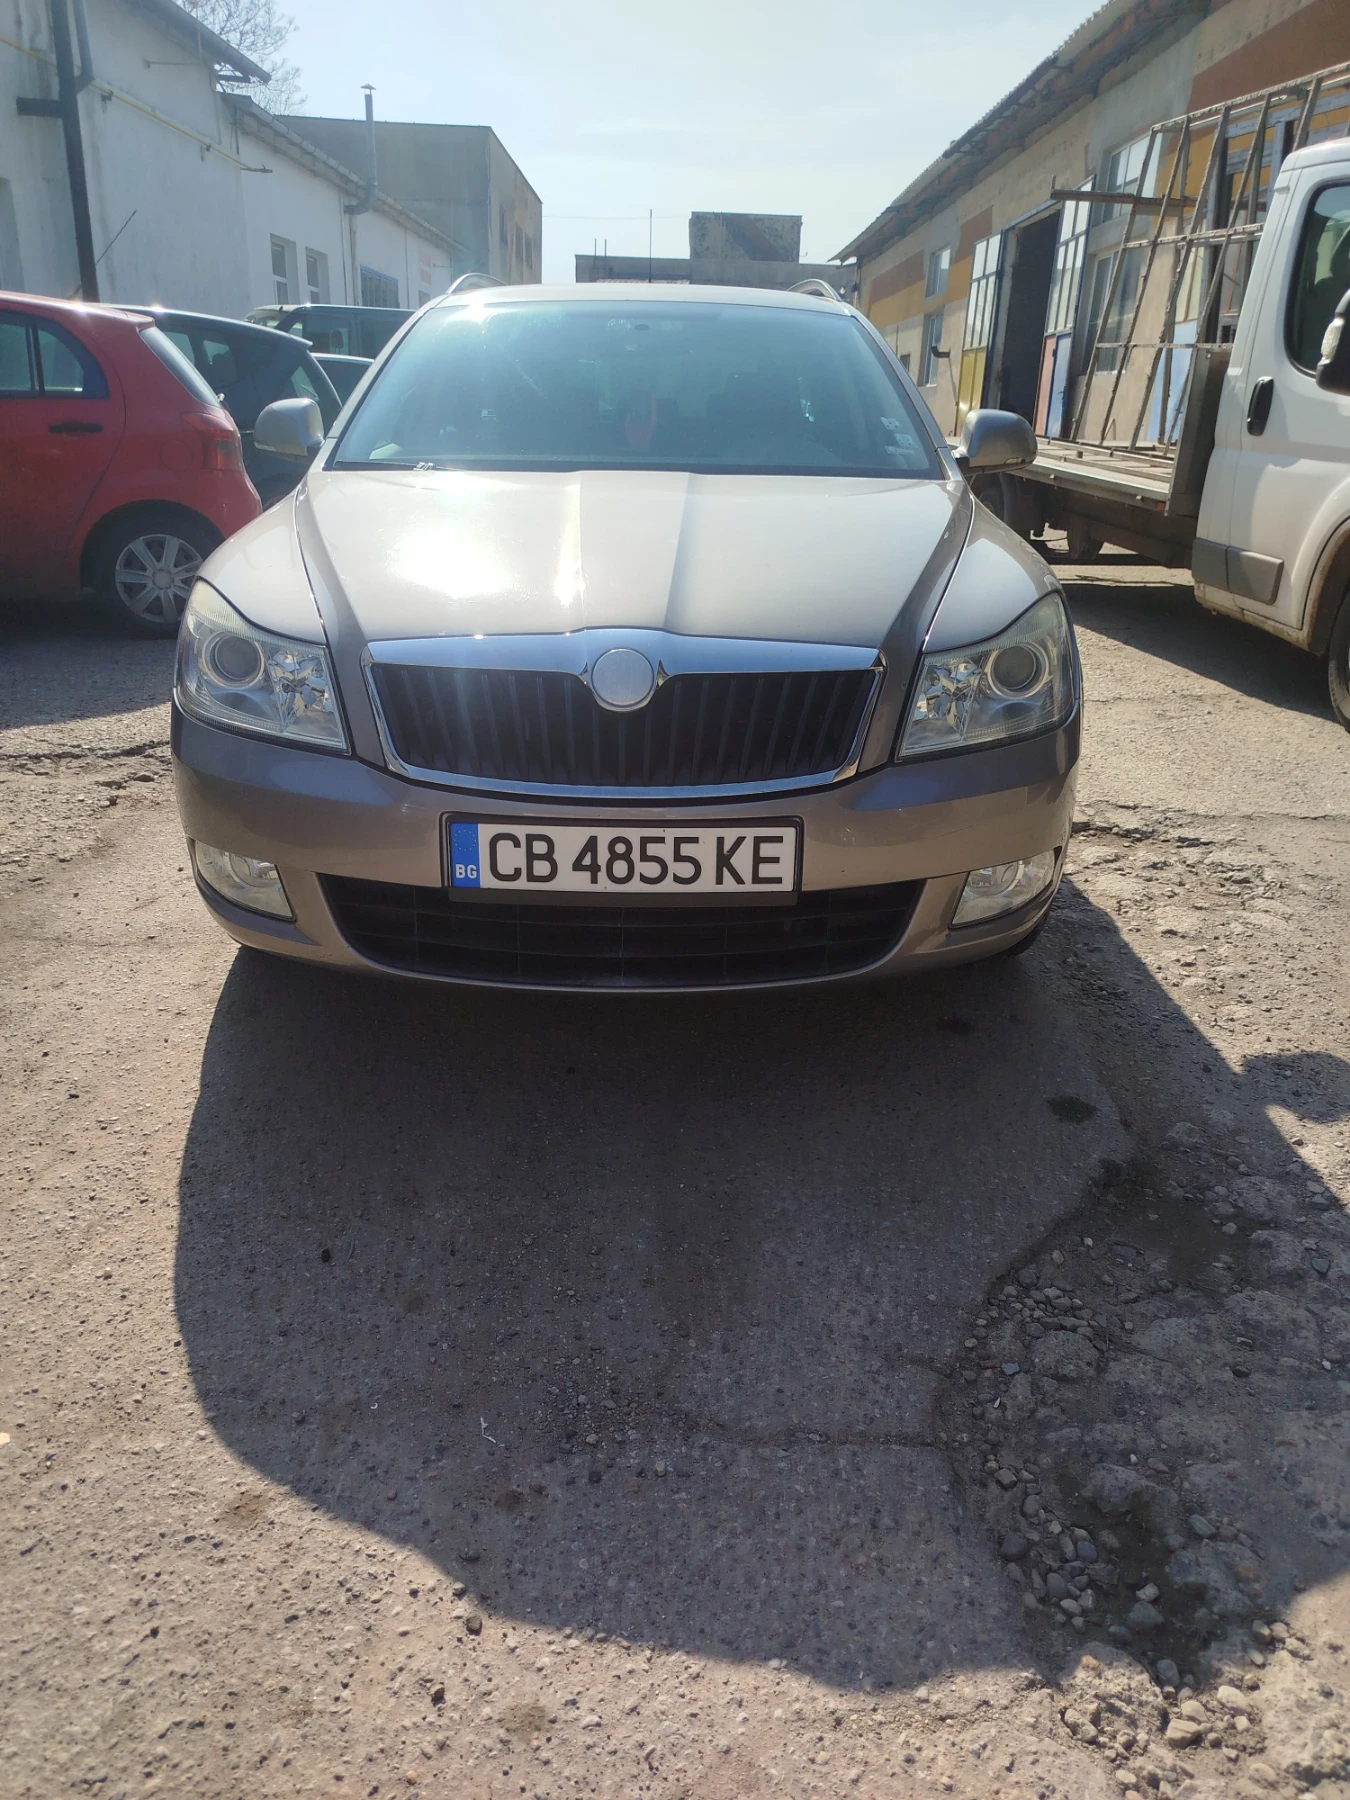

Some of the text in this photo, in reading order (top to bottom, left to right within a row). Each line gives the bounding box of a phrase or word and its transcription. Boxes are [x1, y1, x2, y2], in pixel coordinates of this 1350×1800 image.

[455, 863, 478, 879] BG
[489, 832, 784, 885] CB 4855 KE
